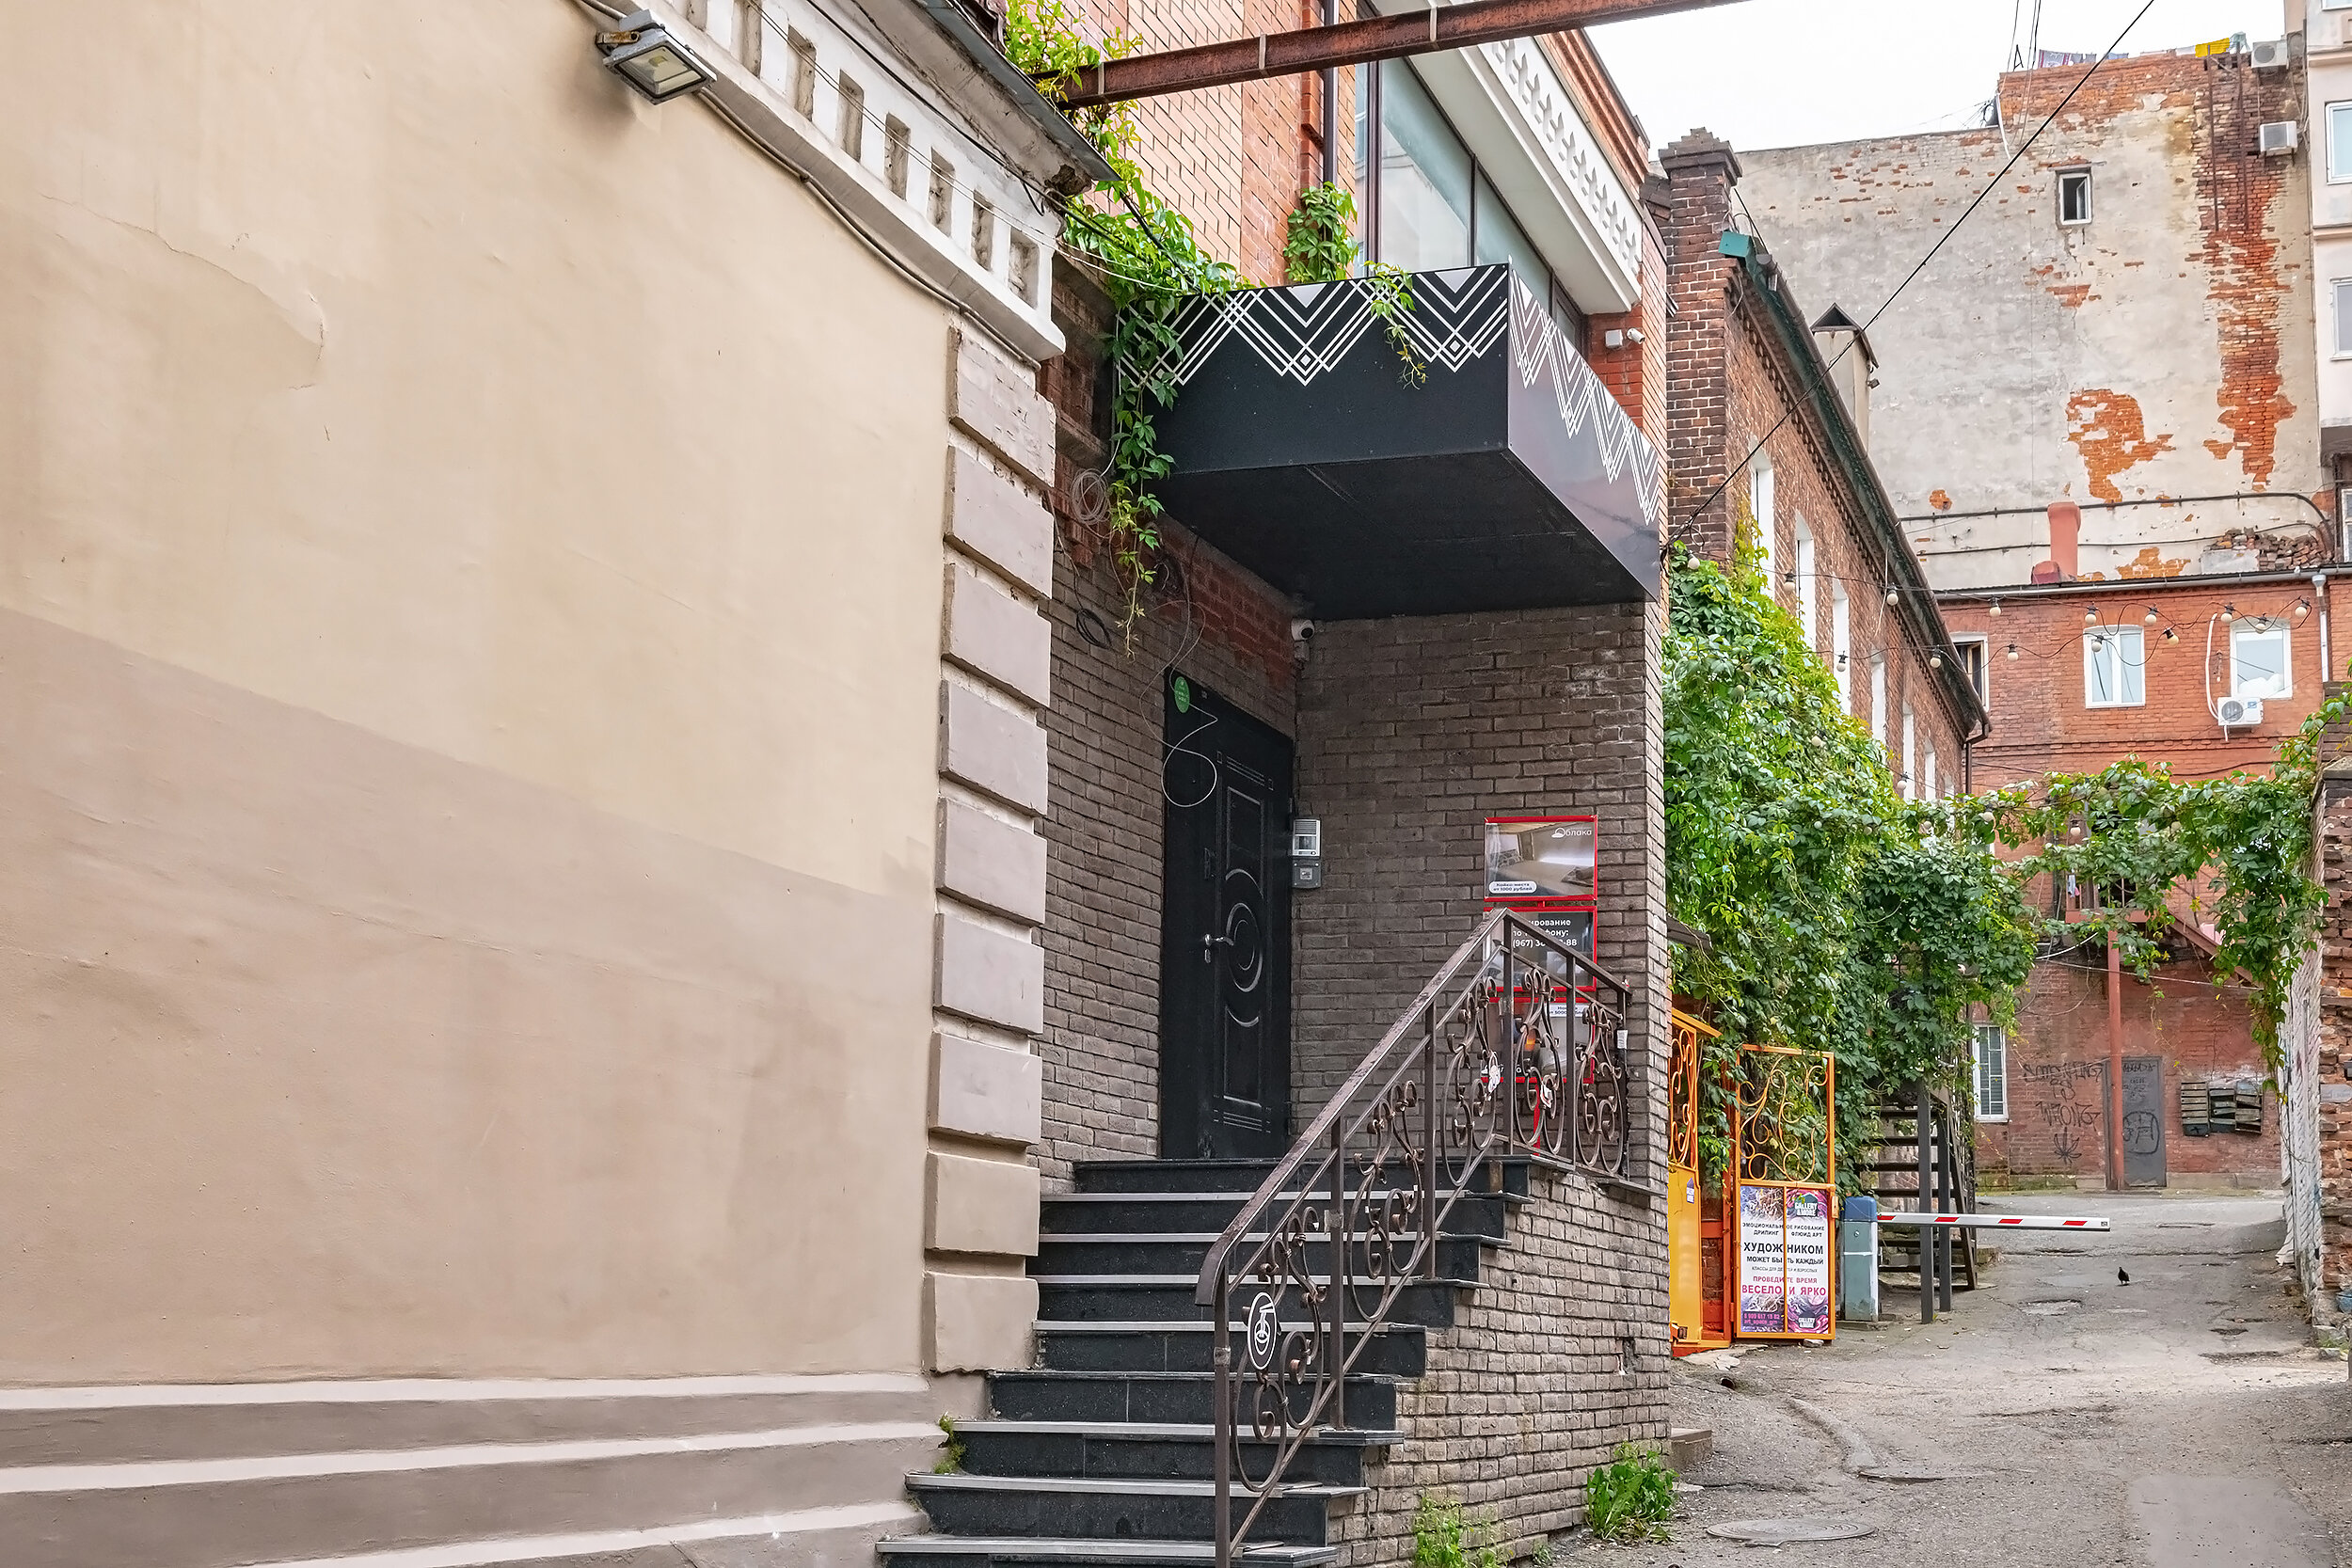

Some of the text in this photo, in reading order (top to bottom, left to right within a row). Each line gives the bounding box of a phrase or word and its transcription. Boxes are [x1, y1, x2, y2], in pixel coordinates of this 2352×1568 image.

[1513, 939, 1534, 948] (967)
[2036, 1101, 2101, 1132] WRONG
[1743, 1242, 1823, 1255] ХУДОЖНИКОМ
[1795, 1257, 1824, 1265] КАЖДЫЙ
[1753, 1275, 1793, 1284] ПРОВЕДИТЕ
[1742, 1284, 1826, 1296] ВЕСЕЛО И ЯРКО
